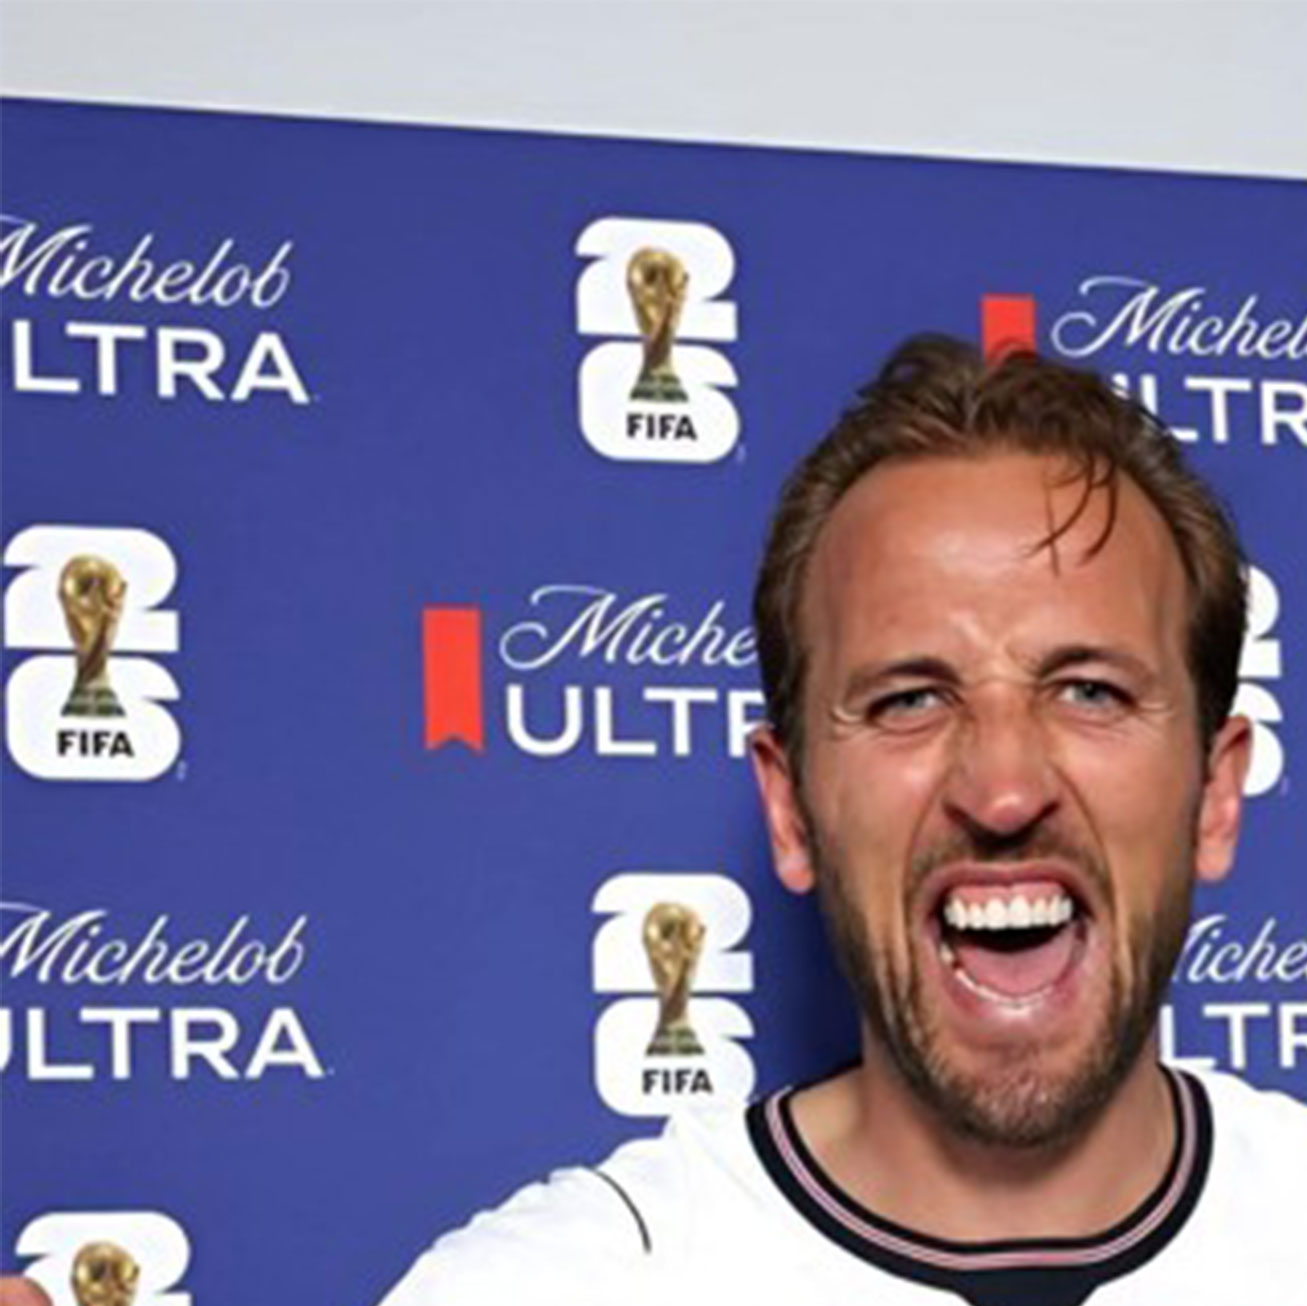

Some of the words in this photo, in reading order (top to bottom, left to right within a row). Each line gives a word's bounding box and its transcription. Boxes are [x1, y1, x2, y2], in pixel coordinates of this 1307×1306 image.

[13, 319, 310, 404] LTRA
[626, 412, 698, 442] FIFA
[500, 585, 759, 670] Miche
[57, 729, 134, 758] FIFA
[0, 902, 308, 985] Michelob
[0, 1007, 324, 1080] LTRA
[642, 1068, 714, 1095] FIFA
